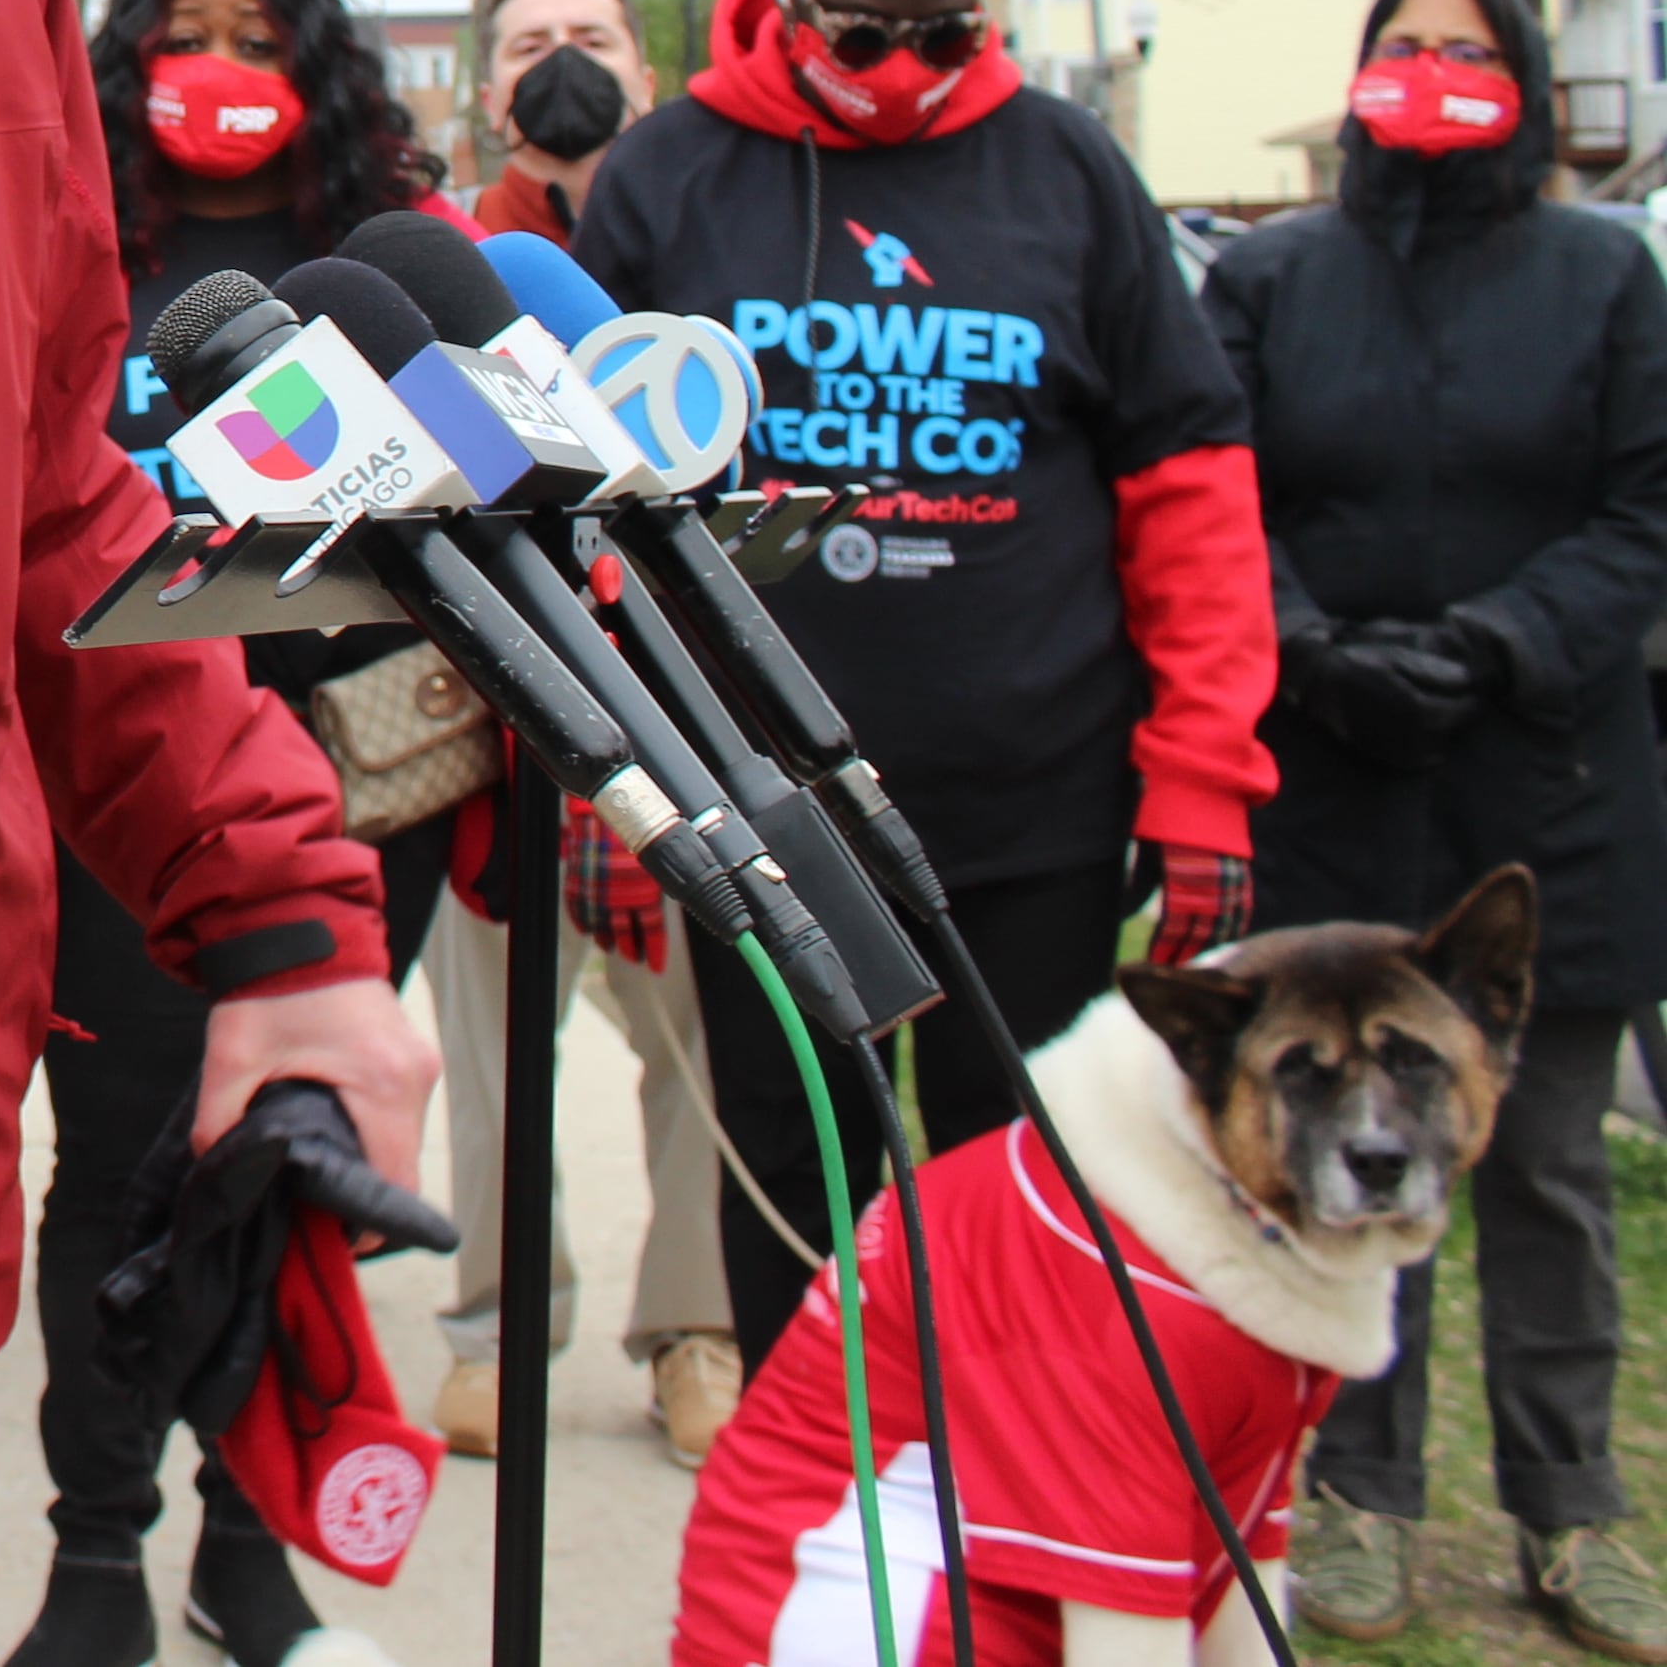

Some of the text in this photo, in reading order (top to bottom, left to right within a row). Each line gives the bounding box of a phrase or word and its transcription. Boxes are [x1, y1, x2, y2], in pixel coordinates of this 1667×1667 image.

[733, 298, 1044, 388] POWER
[817, 372, 965, 415] TO THE
[748, 407, 900, 469] TECH
[301, 435, 408, 515] TICIAS
